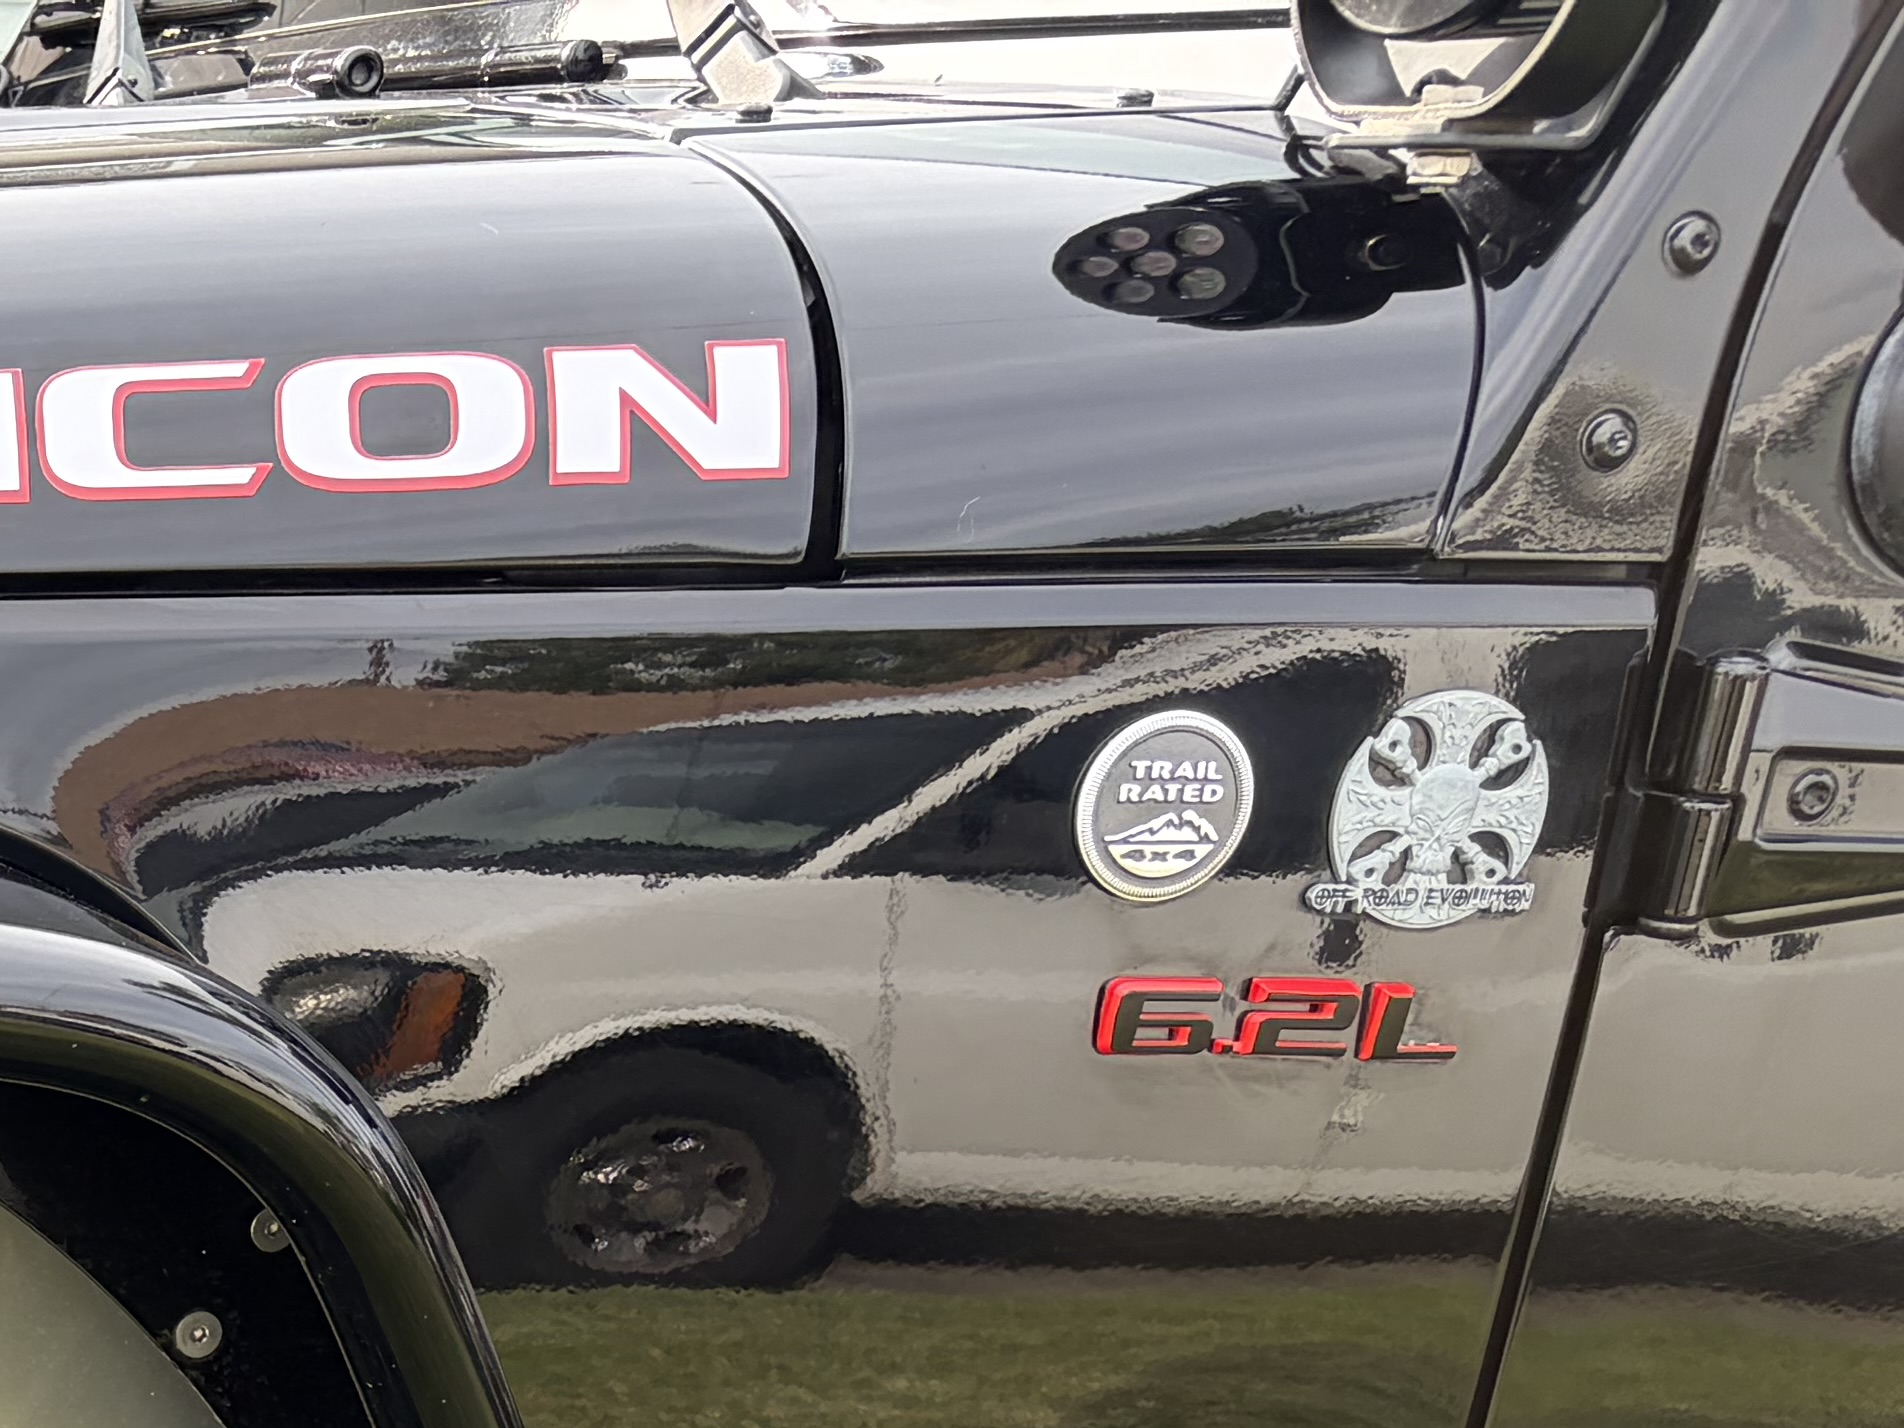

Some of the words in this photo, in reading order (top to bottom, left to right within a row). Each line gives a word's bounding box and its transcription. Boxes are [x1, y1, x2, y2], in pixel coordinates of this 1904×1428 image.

[1129, 759, 1224, 782] TRAIL
[1117, 782, 1226, 804] RATED
[1314, 887, 1356, 908] OFF
[1361, 887, 1419, 908] ROAD
[1423, 886, 1535, 908] EVOLUTION
[1093, 975, 1459, 1061] 6.2L
